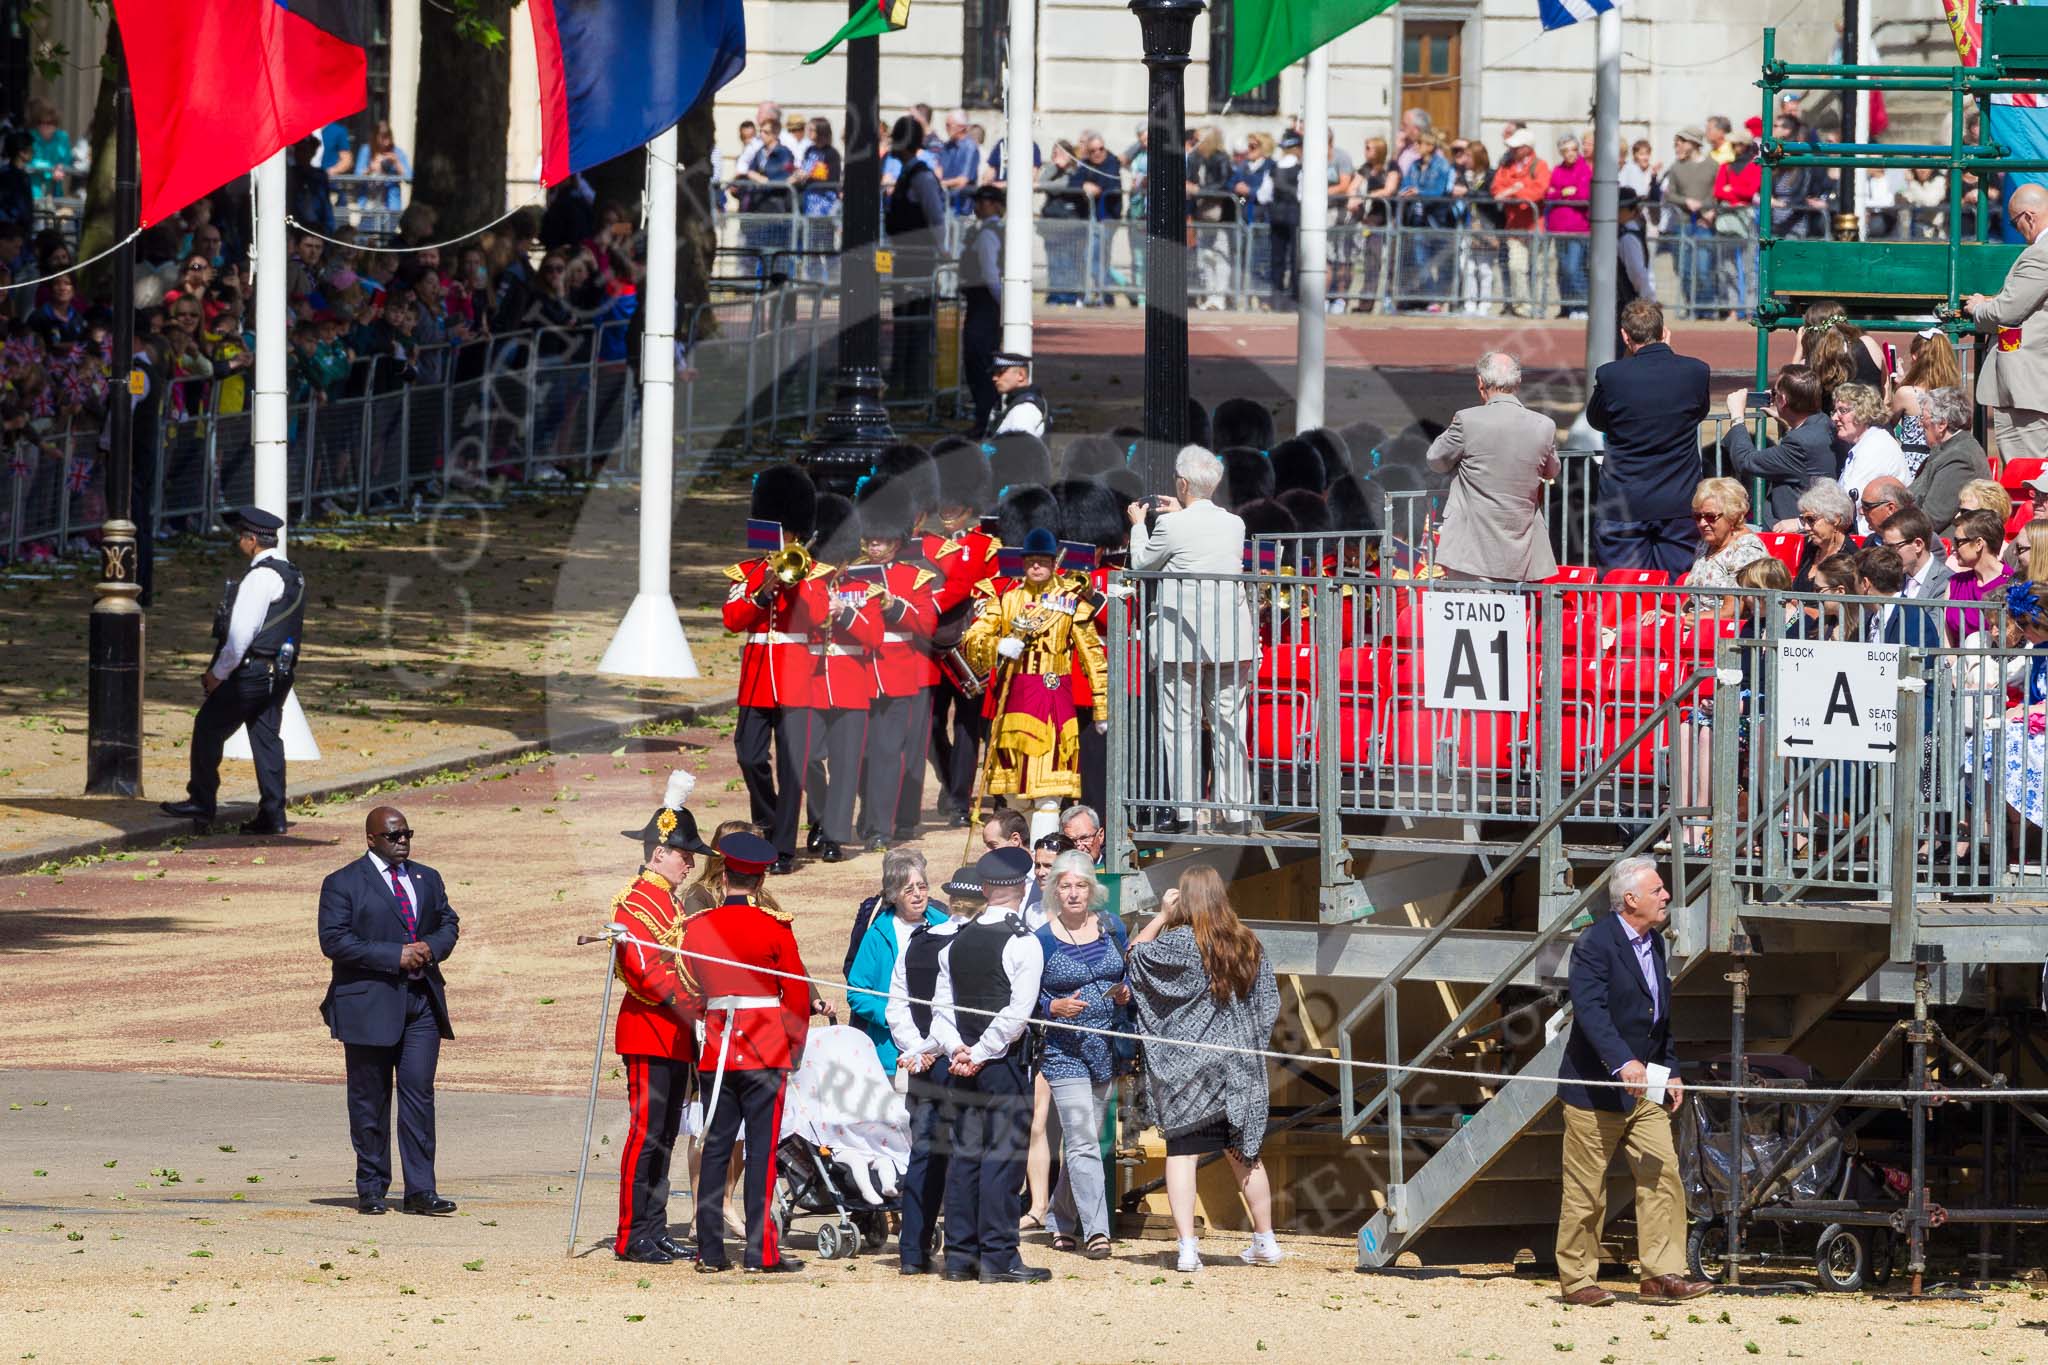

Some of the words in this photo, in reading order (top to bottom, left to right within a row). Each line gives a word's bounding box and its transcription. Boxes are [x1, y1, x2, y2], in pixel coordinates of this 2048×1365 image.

[1443, 601, 1505, 622] STAND
[1783, 646, 1814, 658] BLOCK
[1867, 650, 1898, 662] BLOCK
[1443, 628, 1510, 701] A1
[1795, 662, 1799, 672] 1
[1880, 666, 1885, 676] 2
[1823, 671, 1860, 726] A
[1868, 708, 1897, 719] SEATS
[1793, 717, 1810, 727] 1-14
[1874, 722, 1892, 733] 1-10
